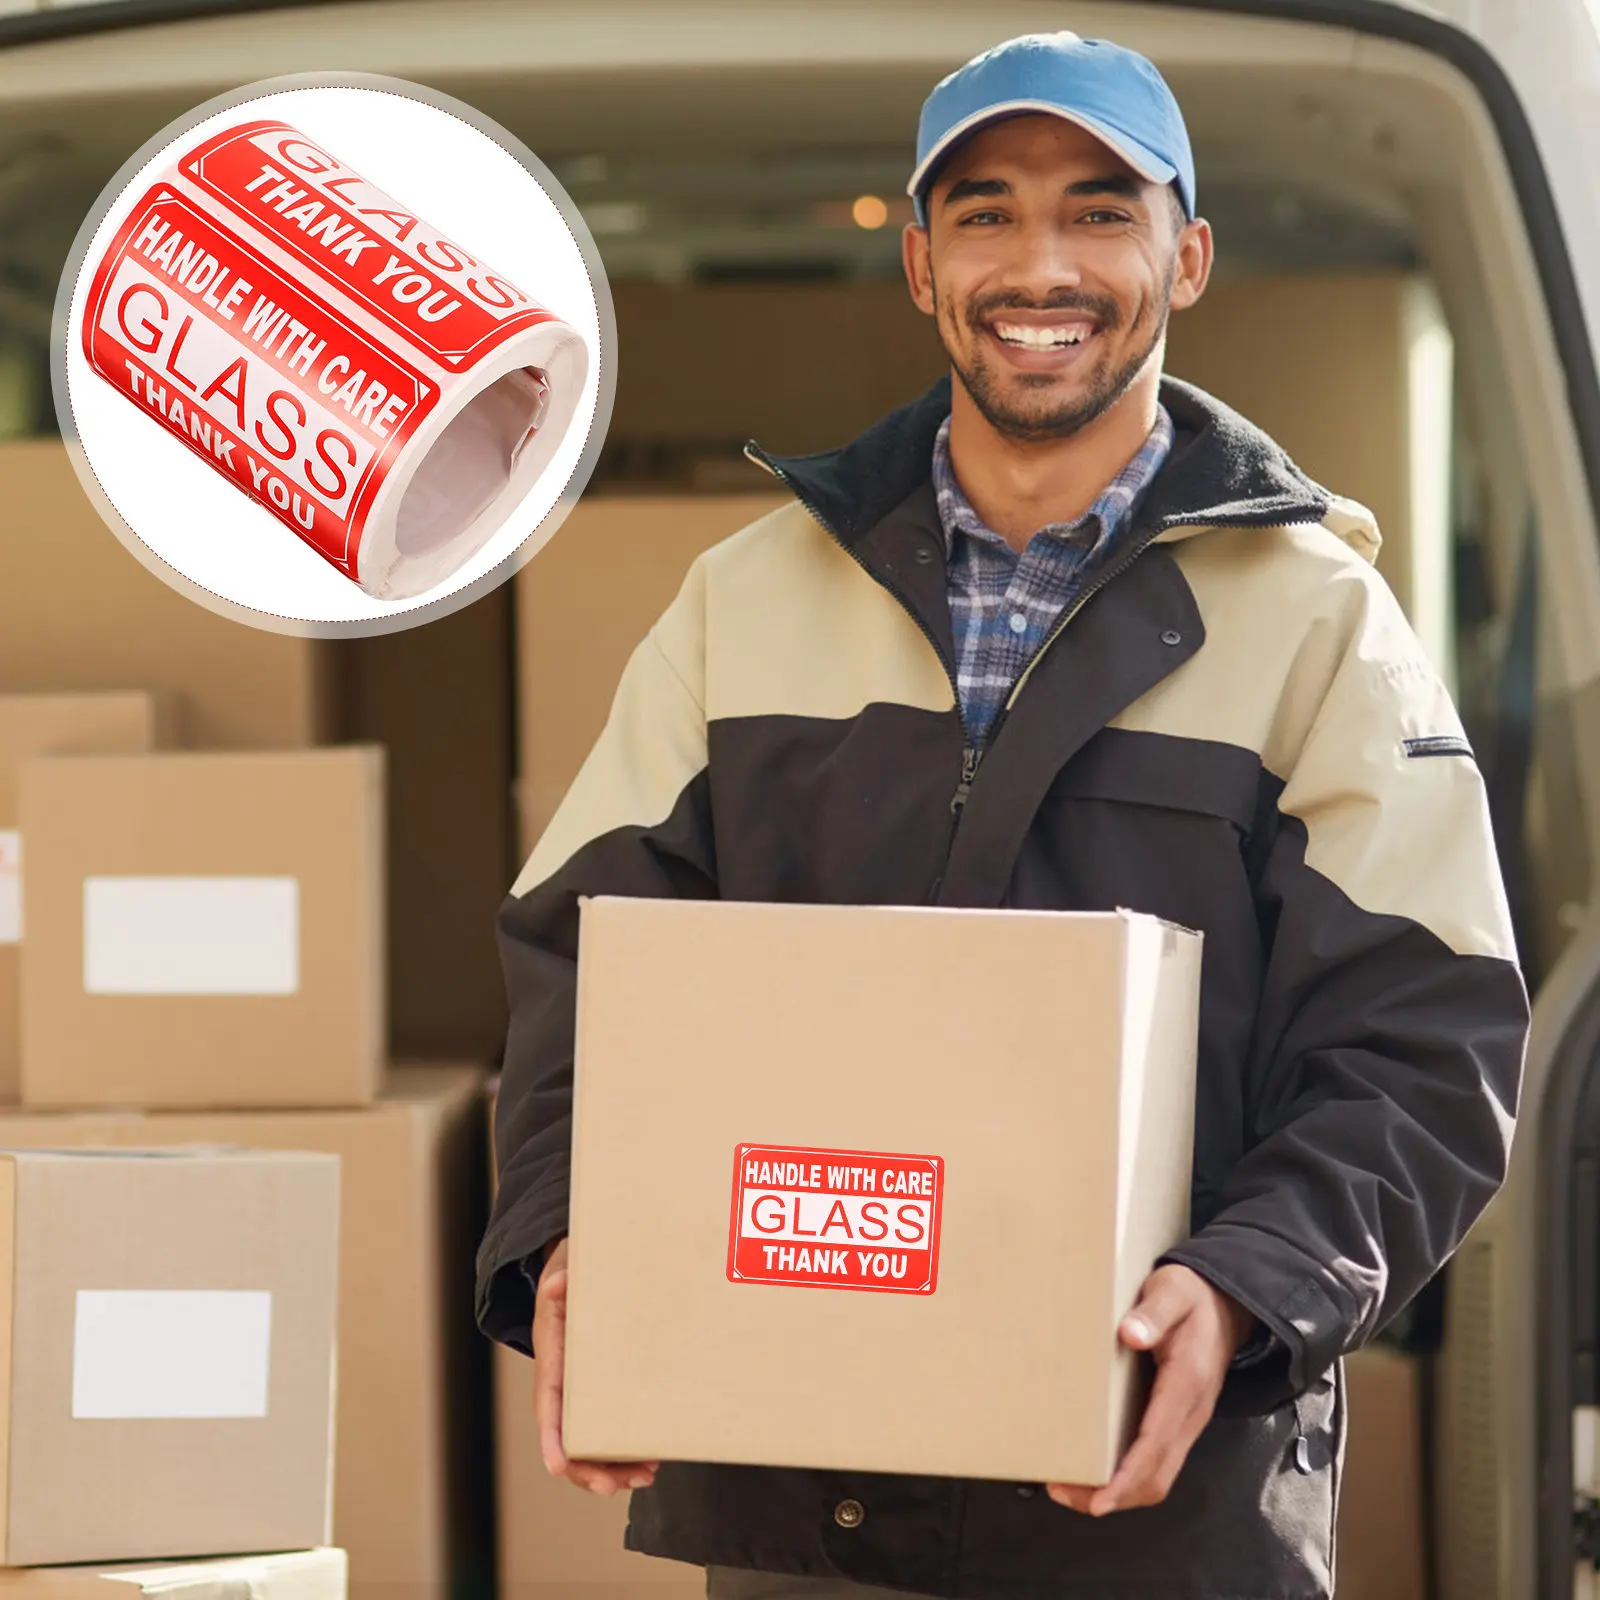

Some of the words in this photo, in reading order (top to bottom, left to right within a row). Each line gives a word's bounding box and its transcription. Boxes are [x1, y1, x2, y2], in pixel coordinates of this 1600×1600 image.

[244, 164, 381, 265] THANK
[371, 253, 462, 322] YOU
[277, 138, 526, 309] GLASS
[117, 282, 357, 500] GLASS
[133, 214, 251, 321] HANDLE
[240, 296, 328, 377] WITH
[319, 351, 408, 437] CARE
[123, 359, 239, 471] THANK
[247, 456, 315, 530] YOU
[745, 1160, 822, 1188] HANDLE
[827, 1165, 876, 1191] WITH
[881, 1169, 933, 1195] CARE
[750, 1194, 925, 1243] GLASS
[762, 1245, 849, 1275] THANK
[857, 1251, 908, 1278] YOU
